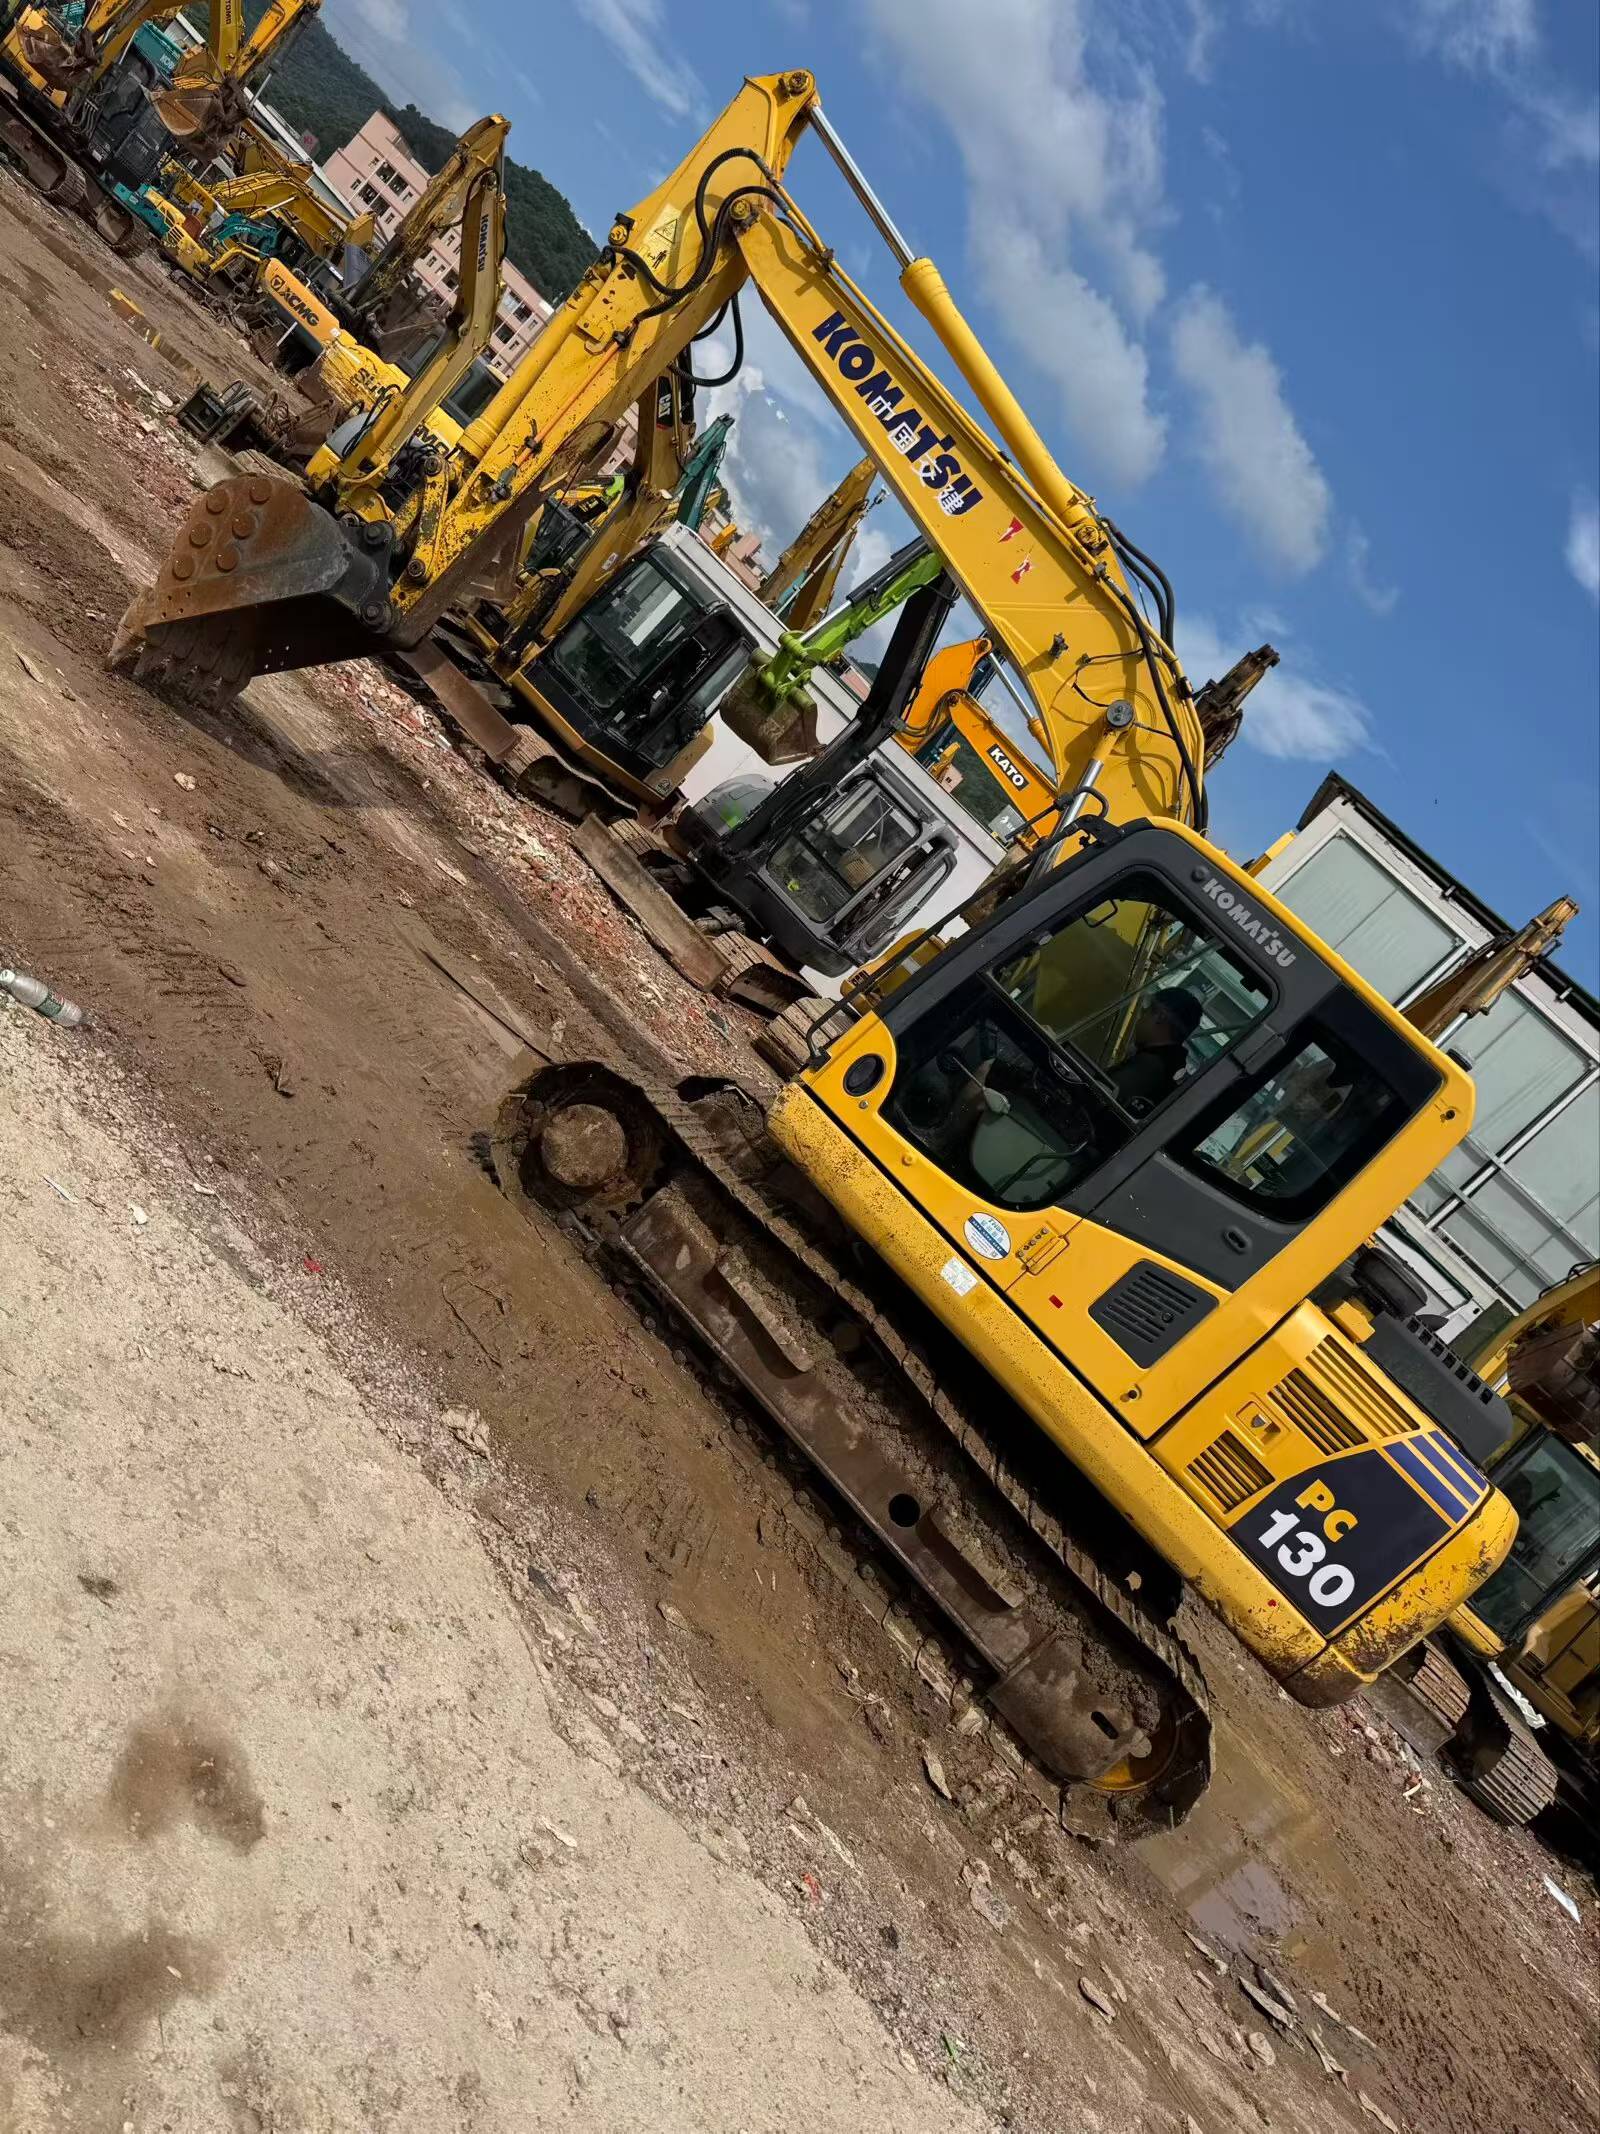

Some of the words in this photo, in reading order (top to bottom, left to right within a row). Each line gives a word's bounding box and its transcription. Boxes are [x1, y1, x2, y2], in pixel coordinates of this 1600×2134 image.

[477, 214, 489, 272] KOMATSU
[279, 286, 320, 327] XCMG
[658, 393, 671, 418] CAT
[811, 310, 984, 516] KOMATSU
[989, 746, 1025, 787] KATO
[1202, 877, 1297, 967] KOMATSU
[1294, 1478, 1359, 1543] PC
[1258, 1508, 1356, 1607] 130
